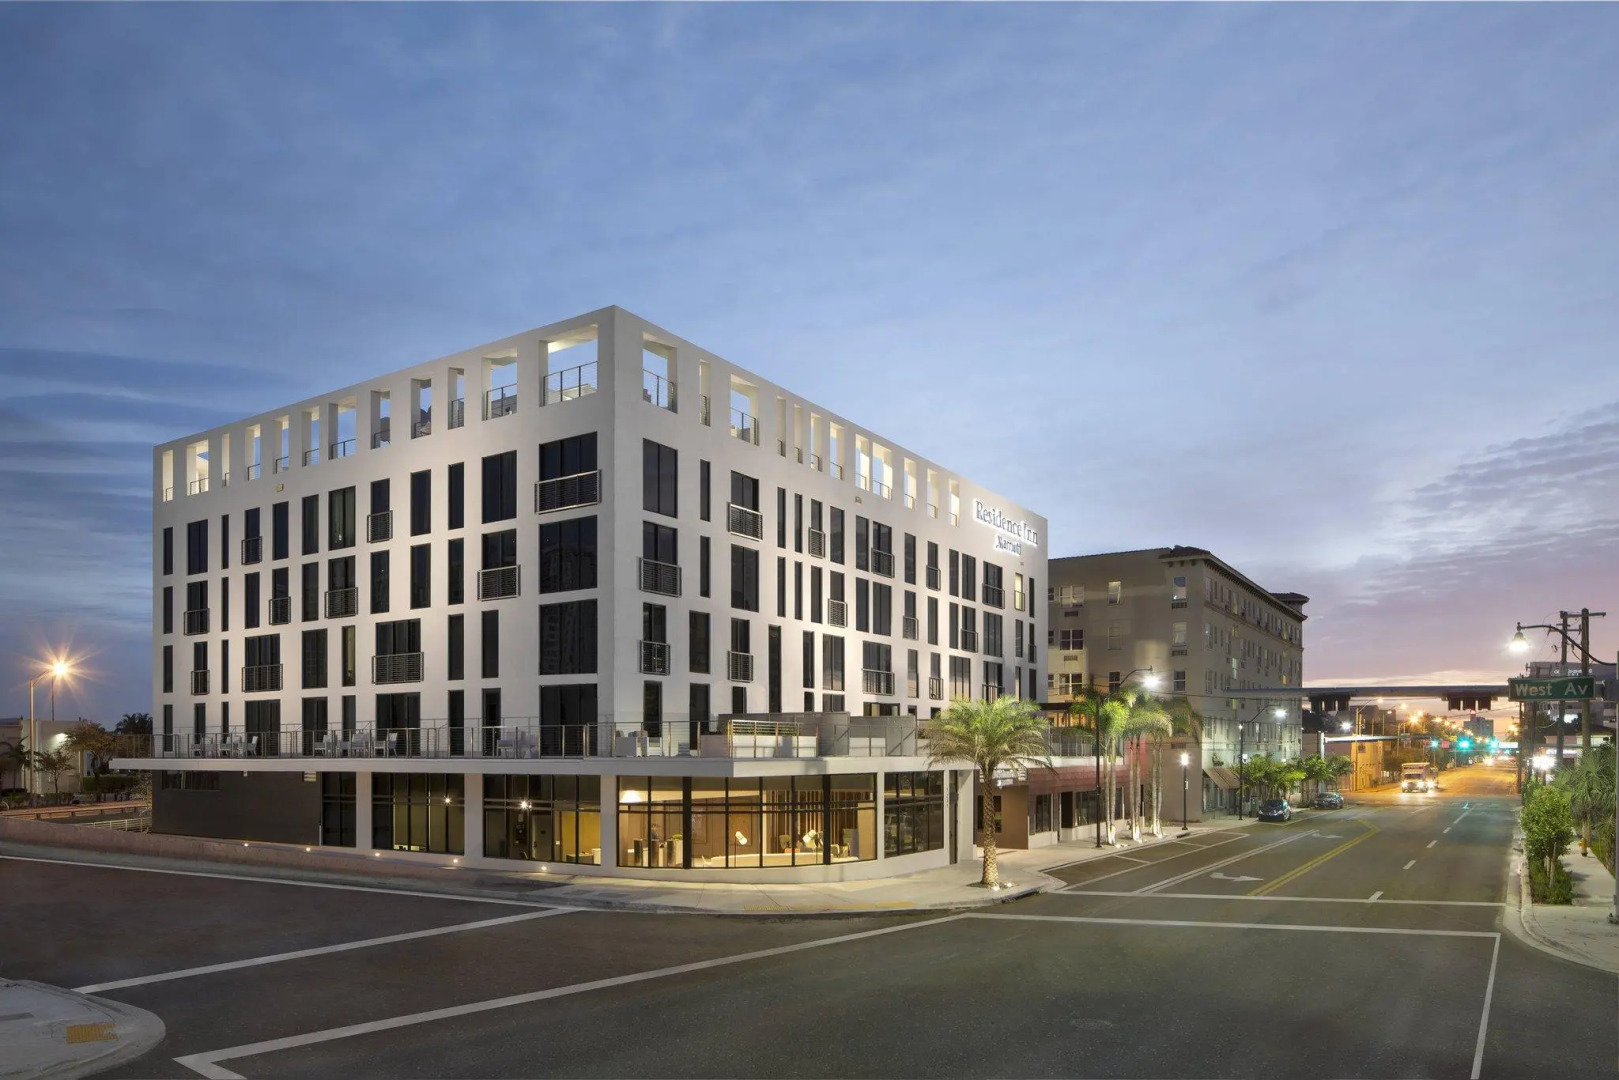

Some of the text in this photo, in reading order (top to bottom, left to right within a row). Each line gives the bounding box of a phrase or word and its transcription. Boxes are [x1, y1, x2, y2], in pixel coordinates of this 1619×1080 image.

[974, 499, 1038, 546] Residence Inn
[1515, 682, 1589, 697] West Av
